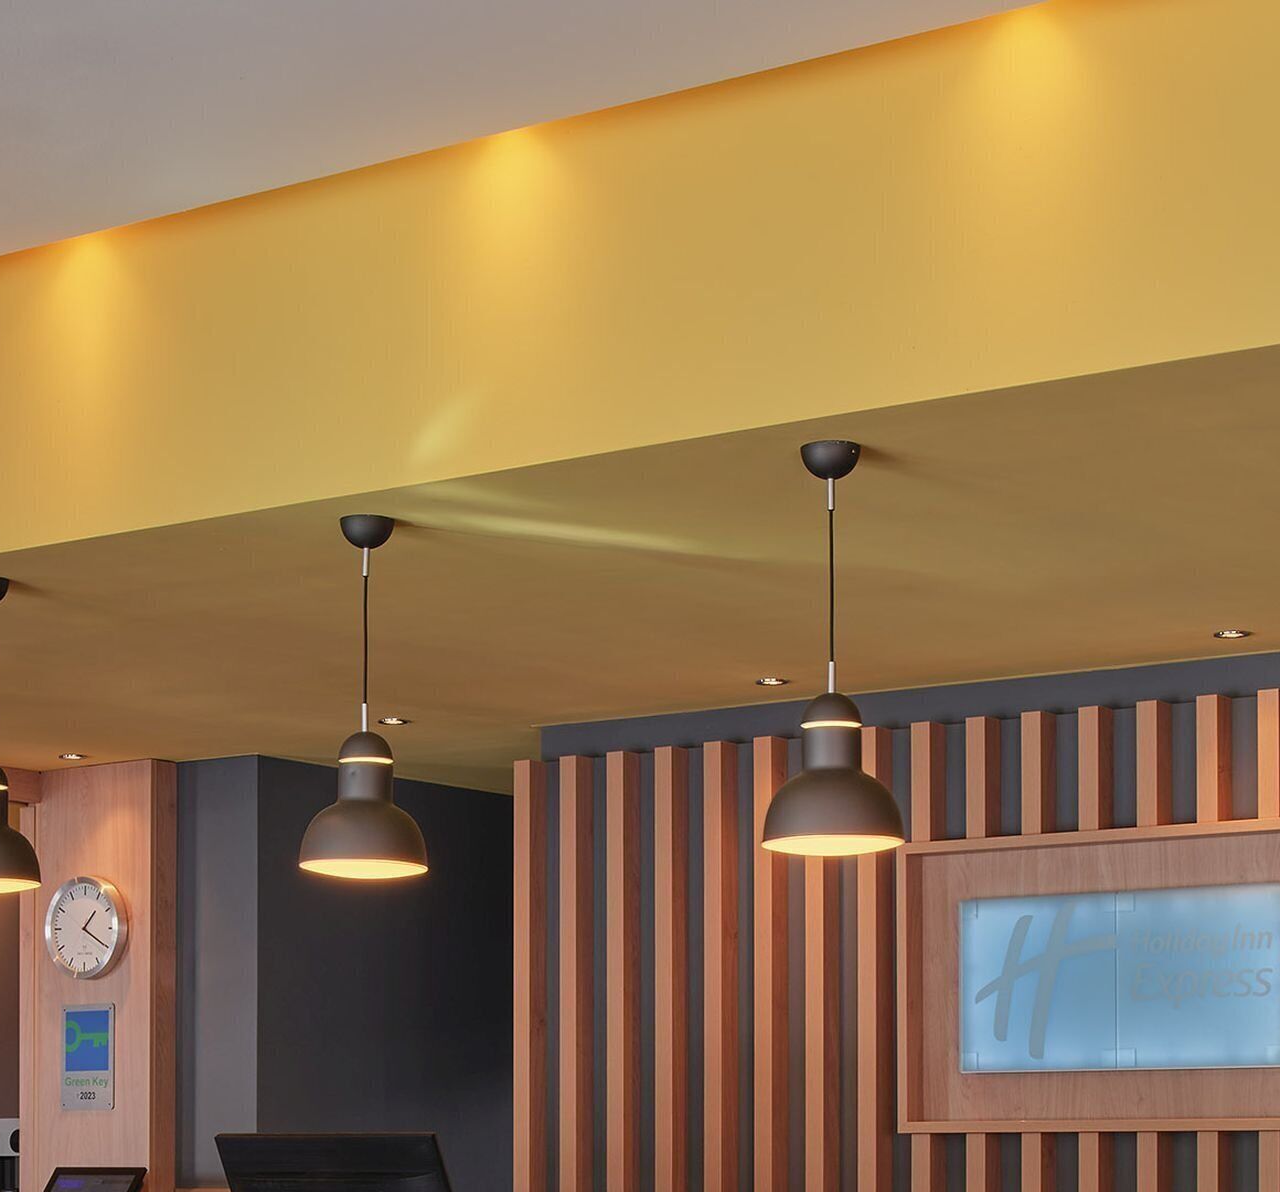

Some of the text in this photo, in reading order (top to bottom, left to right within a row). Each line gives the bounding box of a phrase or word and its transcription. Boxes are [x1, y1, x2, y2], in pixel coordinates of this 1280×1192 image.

[1232, 923, 1273, 950] Inn
[1131, 962, 1273, 1008] Express
[64, 1076, 108, 1088] Green Key
[80, 1091, 96, 1100] 2023
